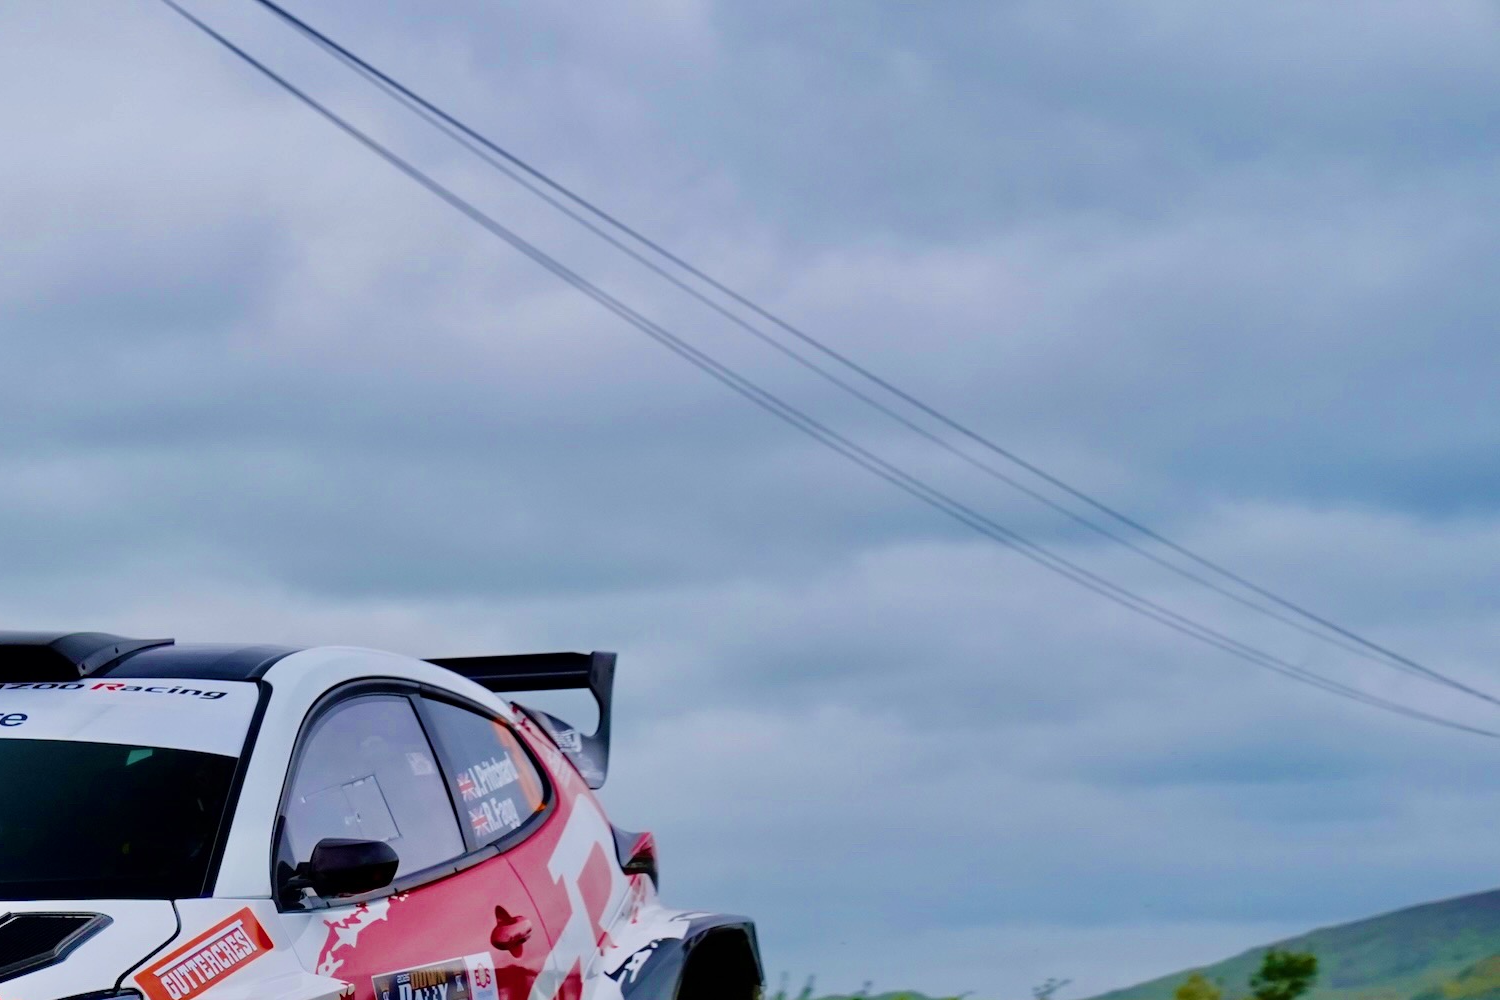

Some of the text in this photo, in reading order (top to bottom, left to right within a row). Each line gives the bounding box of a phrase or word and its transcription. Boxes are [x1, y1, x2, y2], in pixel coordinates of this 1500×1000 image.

[91, 683, 228, 700] Racing
[155, 919, 258, 1000] GUTTERCREST
[410, 968, 447, 990] DOWN
